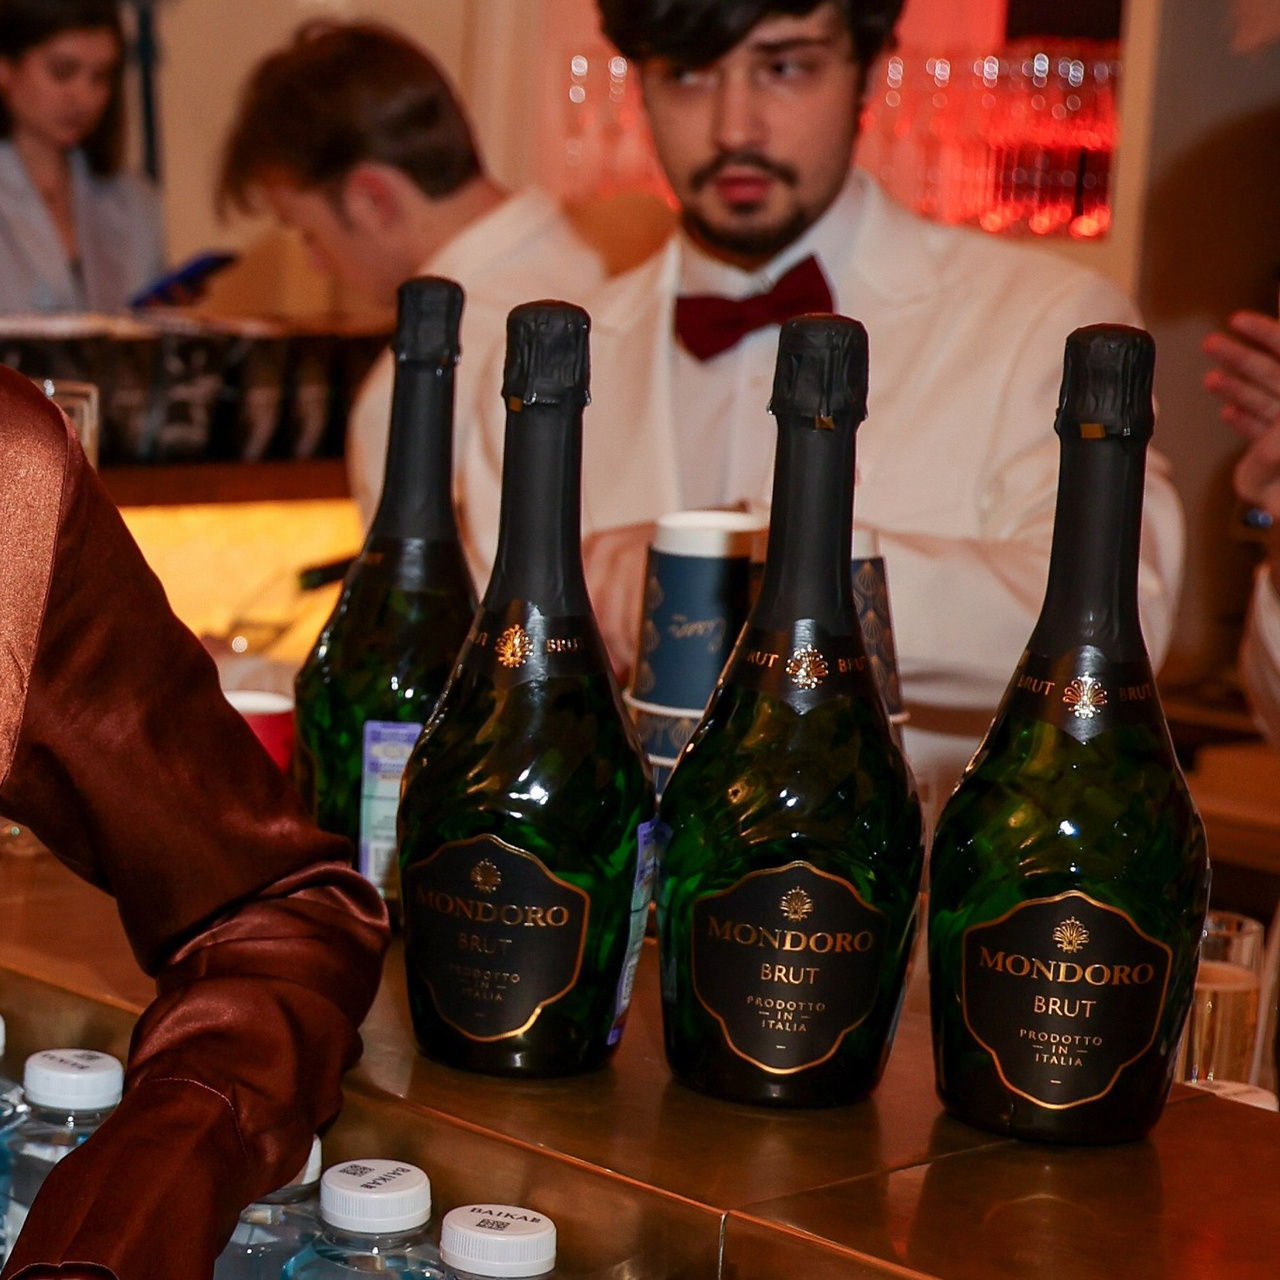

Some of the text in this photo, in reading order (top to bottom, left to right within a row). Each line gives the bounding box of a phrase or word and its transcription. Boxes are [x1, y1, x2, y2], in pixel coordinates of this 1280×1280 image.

[1118, 684, 1151, 702] BRUT
[416, 886, 569, 927] MONDORO
[458, 932, 513, 955] BRUT
[707, 915, 873, 954] MONDORO
[760, 963, 820, 985] BRUT
[978, 946, 1154, 986] MONDORO
[747, 995, 826, 1012] PRODOTTO
[1033, 995, 1097, 1018] BRUT
[777, 1011, 794, 1020] IN
[761, 1020, 807, 1032] ITALIA
[1019, 1028, 1103, 1047] PRODOTTO
[1051, 1044, 1068, 1055] IN
[1035, 1053, 1083, 1067] ITALIA
